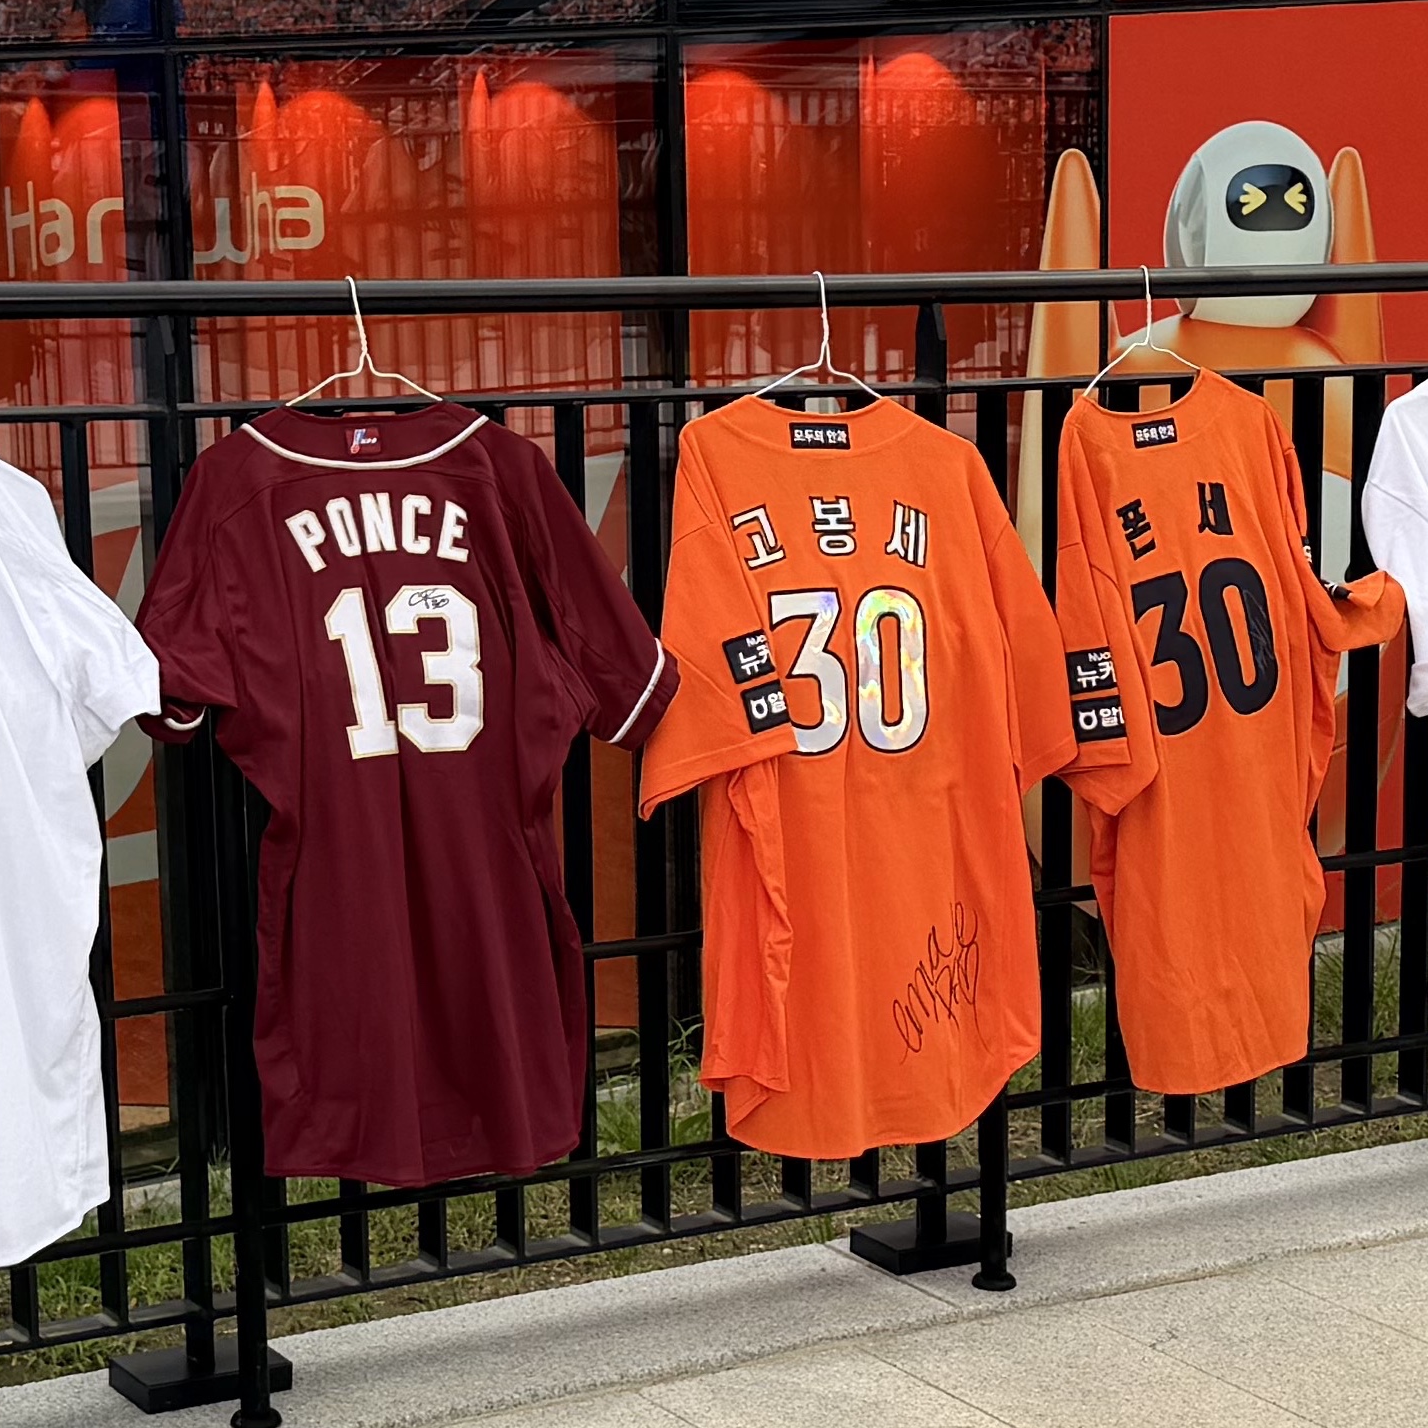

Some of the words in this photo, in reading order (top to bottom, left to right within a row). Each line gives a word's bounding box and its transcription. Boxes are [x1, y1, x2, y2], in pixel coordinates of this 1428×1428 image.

[794, 429, 825, 444] 모두의
[285, 492, 470, 573] PONCE
[324, 584, 484, 760] 13
[767, 587, 929, 755] 30
[1130, 556, 1279, 736] 30
